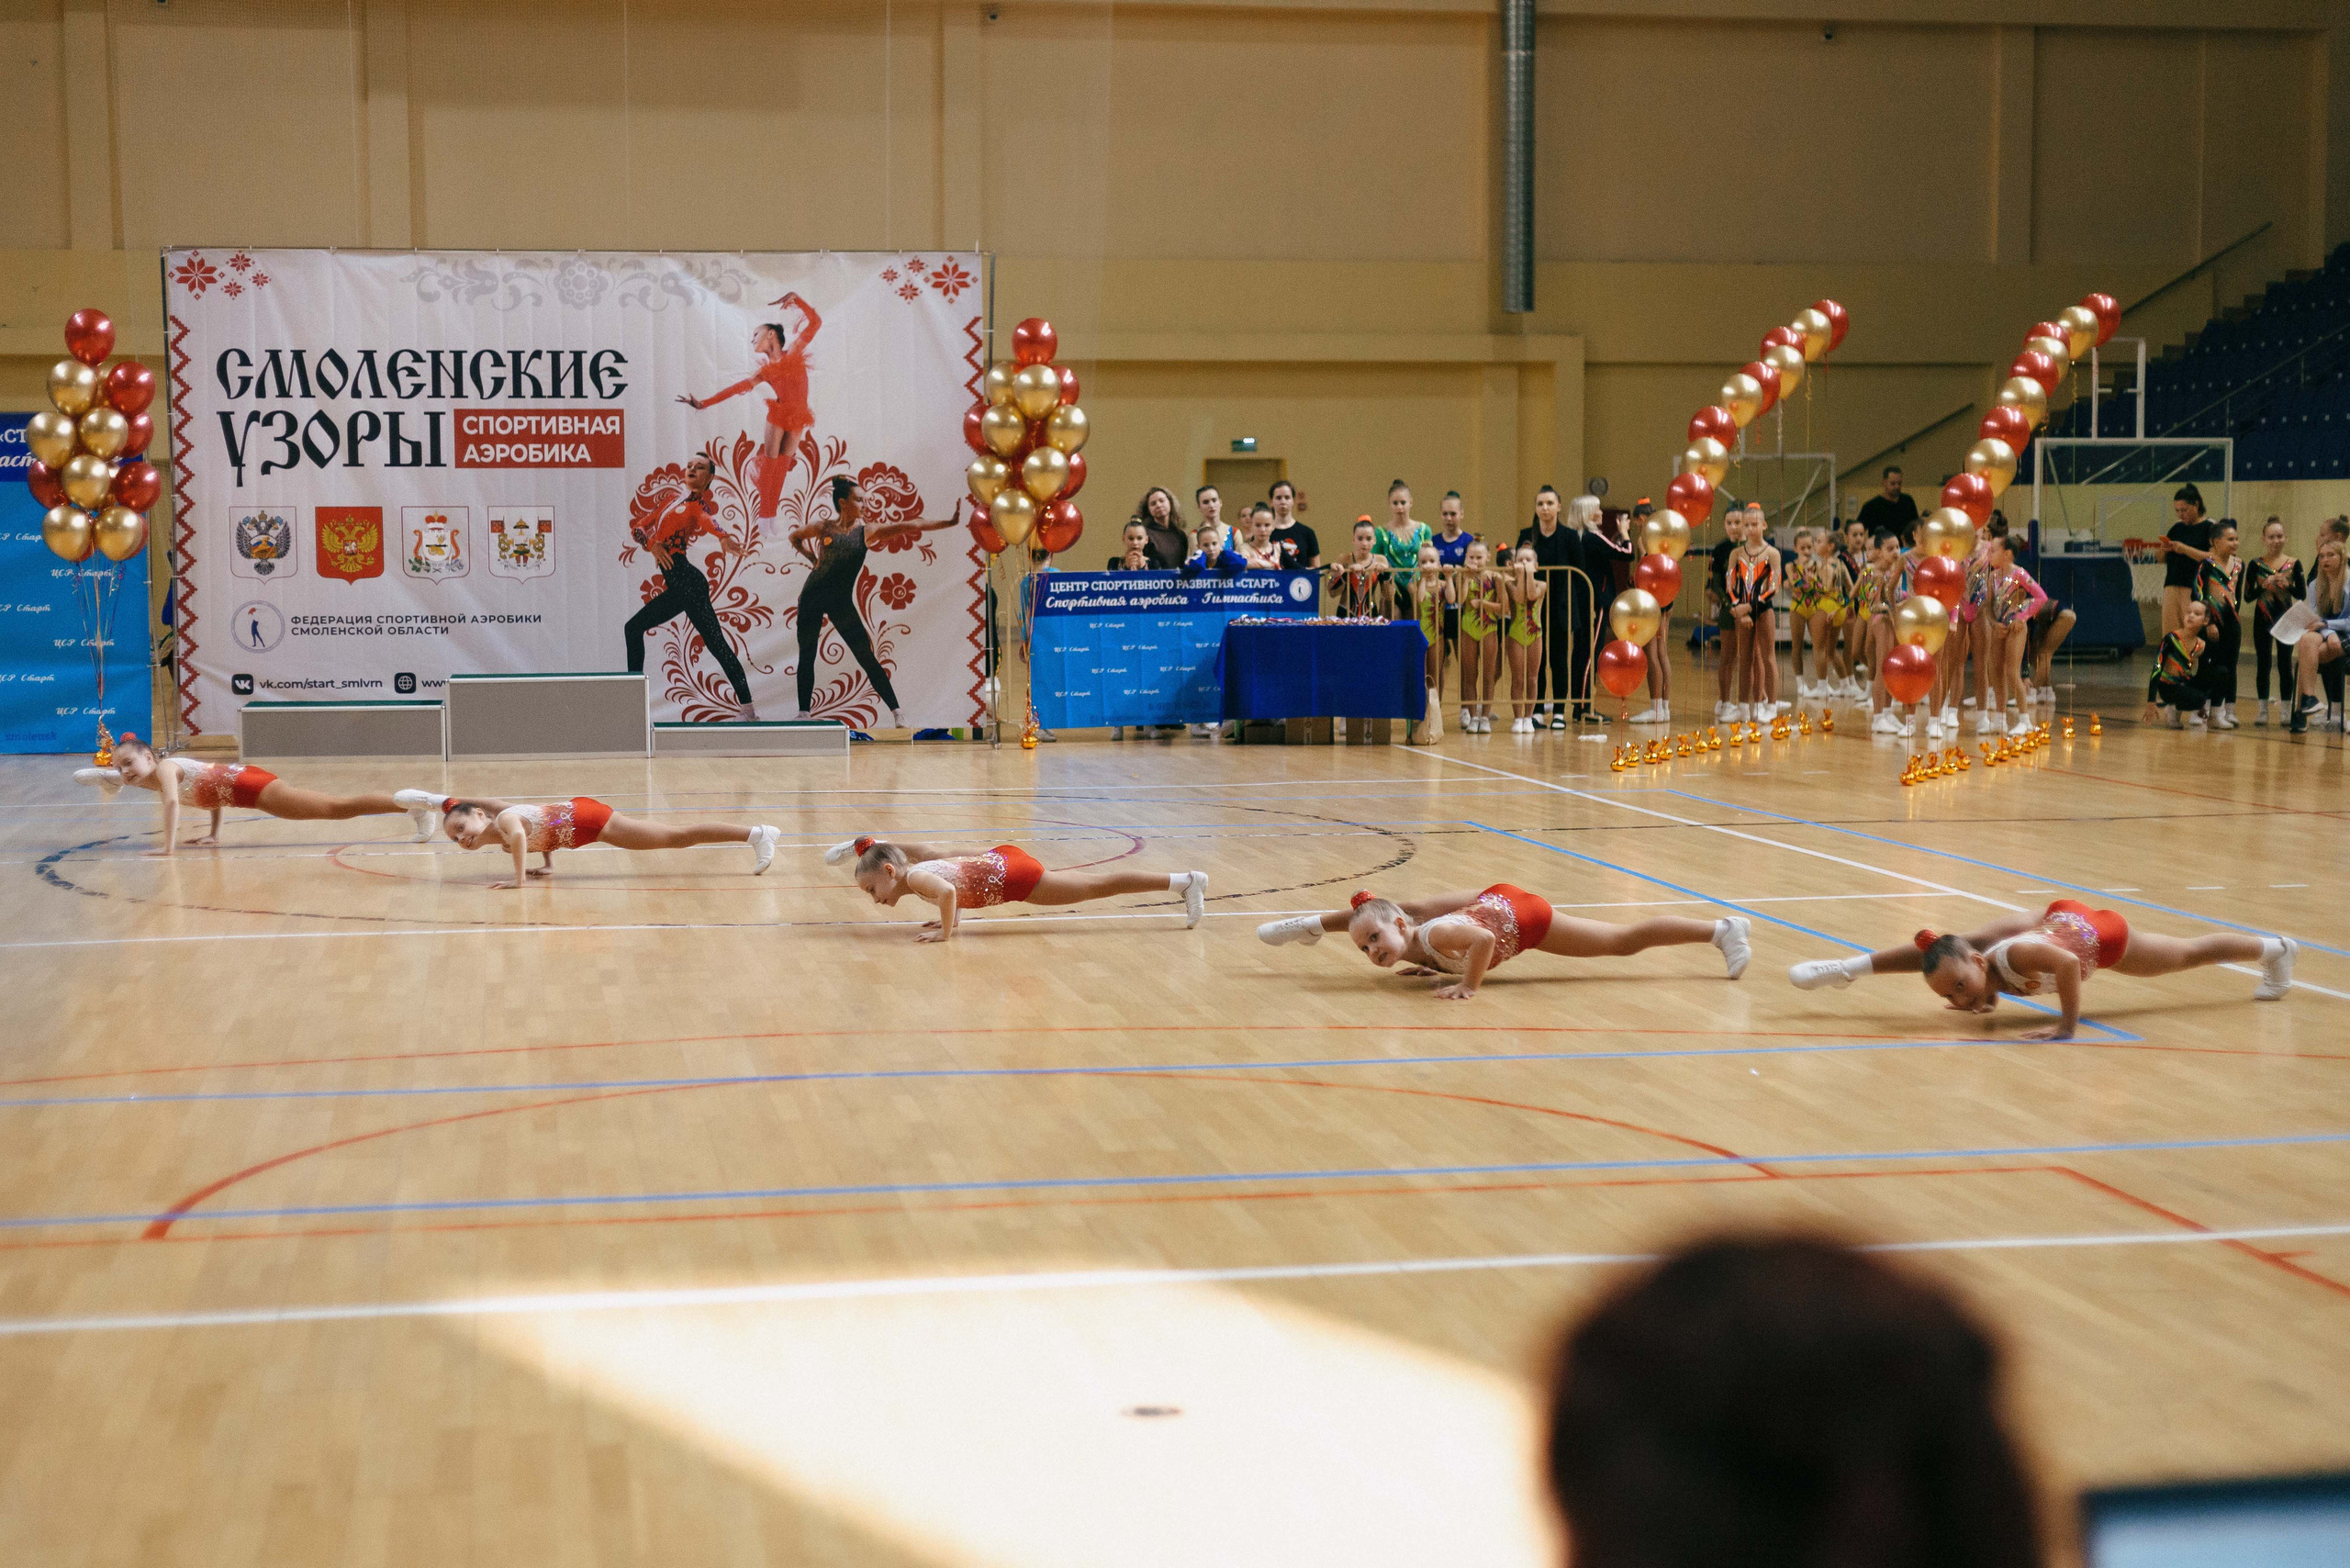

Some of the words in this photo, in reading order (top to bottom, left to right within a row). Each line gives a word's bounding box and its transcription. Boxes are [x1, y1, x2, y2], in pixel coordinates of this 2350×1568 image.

[216, 348, 628, 399] СМОЛЕНСКИЕ
[463, 416, 621, 435] СПОРТИВНАЯ
[217, 409, 447, 487] УЗОРЫ
[463, 443, 592, 463] АЭРОБИКА
[1050, 581, 1090, 594] ЦЕНТР
[1091, 579, 1174, 592] СПОРТИВНОГО
[1176, 578, 1235, 589] РАЗВИТИЯ
[1236, 578, 1280, 588] «СТАРТ»
[1046, 595, 1127, 611] Спортивная
[1129, 593, 1189, 610] аэробика
[1202, 592, 1284, 604] Гимнастика
[290, 615, 372, 626] ФЕДЕРАЦИЯ
[376, 613, 466, 624] СПОРТИВНОЙ
[471, 614, 542, 623] АЭРОБИКИ
[291, 625, 383, 635] СМОЛЕНСКОЙ
[387, 626, 449, 635] ОБЛАСТИ
[259, 678, 383, 689] vk.com/start_smlvrn
